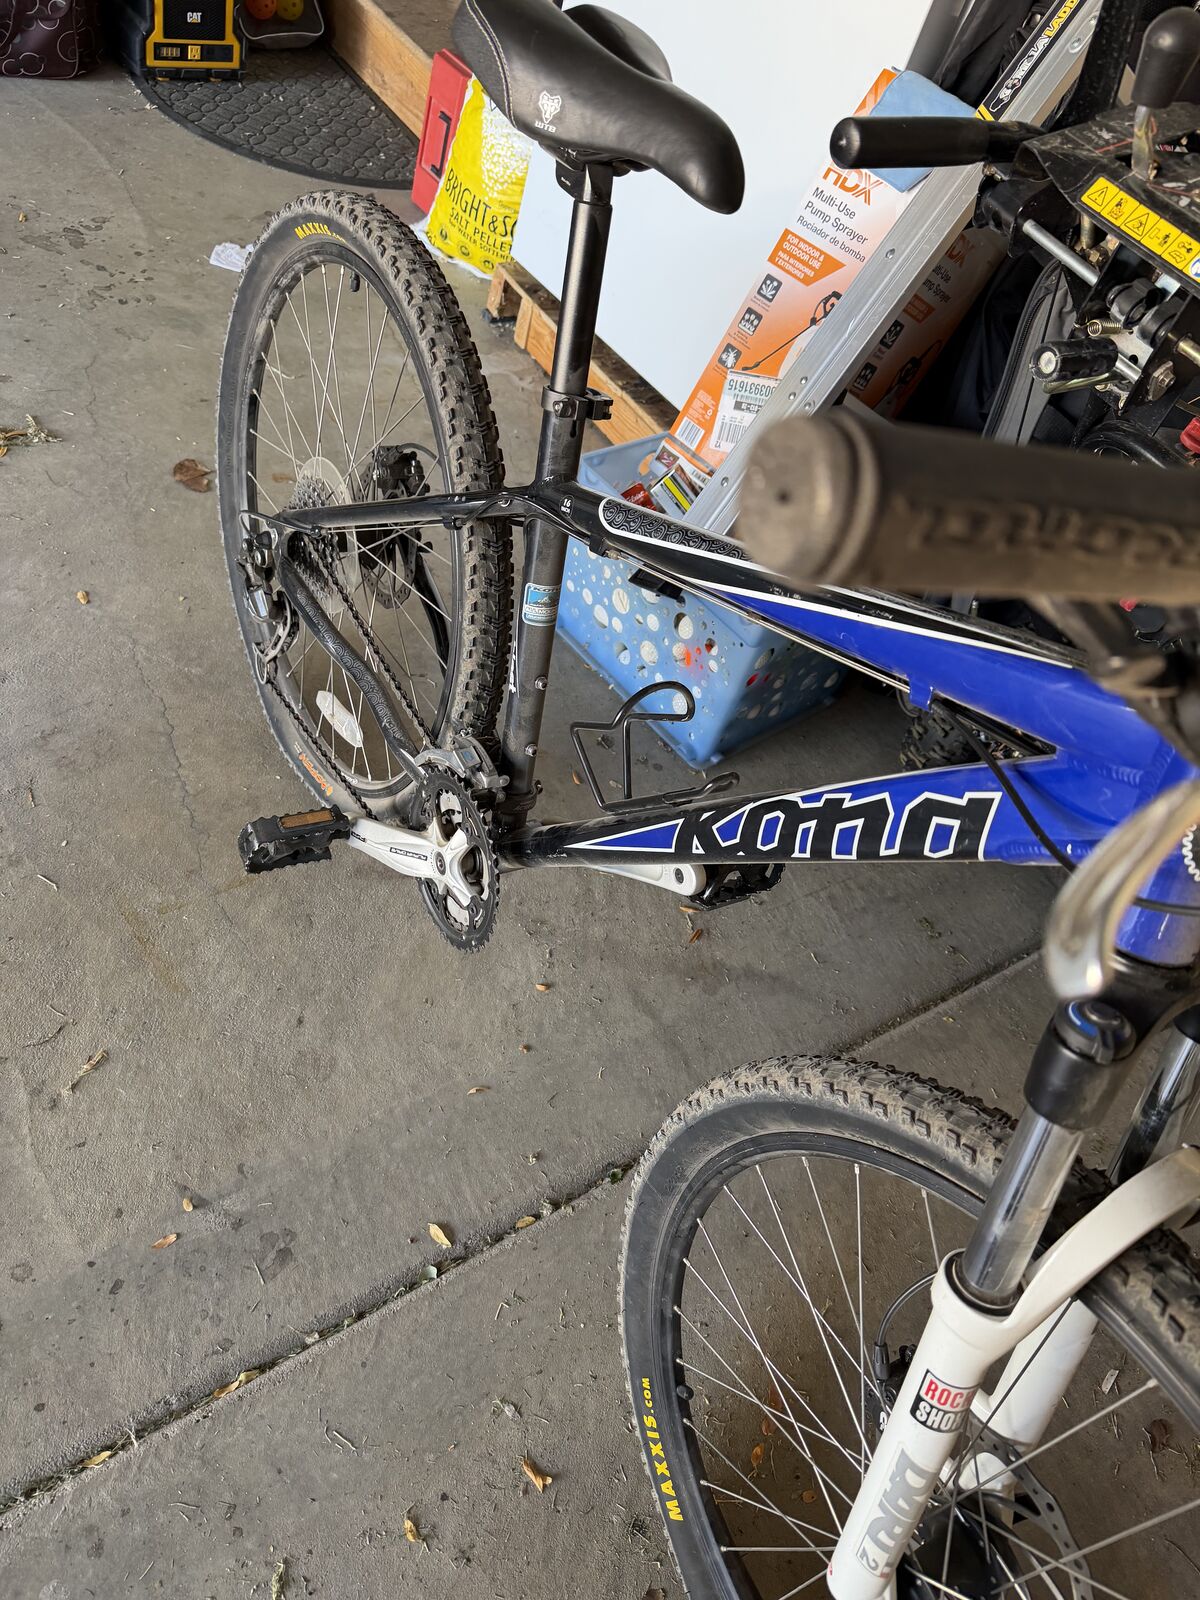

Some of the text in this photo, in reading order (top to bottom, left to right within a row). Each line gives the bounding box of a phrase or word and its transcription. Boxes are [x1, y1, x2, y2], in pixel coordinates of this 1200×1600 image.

[186, 11, 203, 23] CAT
[534, 120, 557, 133] WTB
[812, 186, 856, 219] Multi-Use
[449, 207, 470, 230] SALT
[804, 200, 868, 245] Pump Sprayer
[786, 234, 799, 246] FOR
[797, 240, 820, 258] INDOOR
[796, 215, 866, 263] Rociador de bomba
[783, 241, 821, 269] OUTDOOR USE
[563, 498, 571, 507] 16
[860, 1546, 879, 1571] 2
